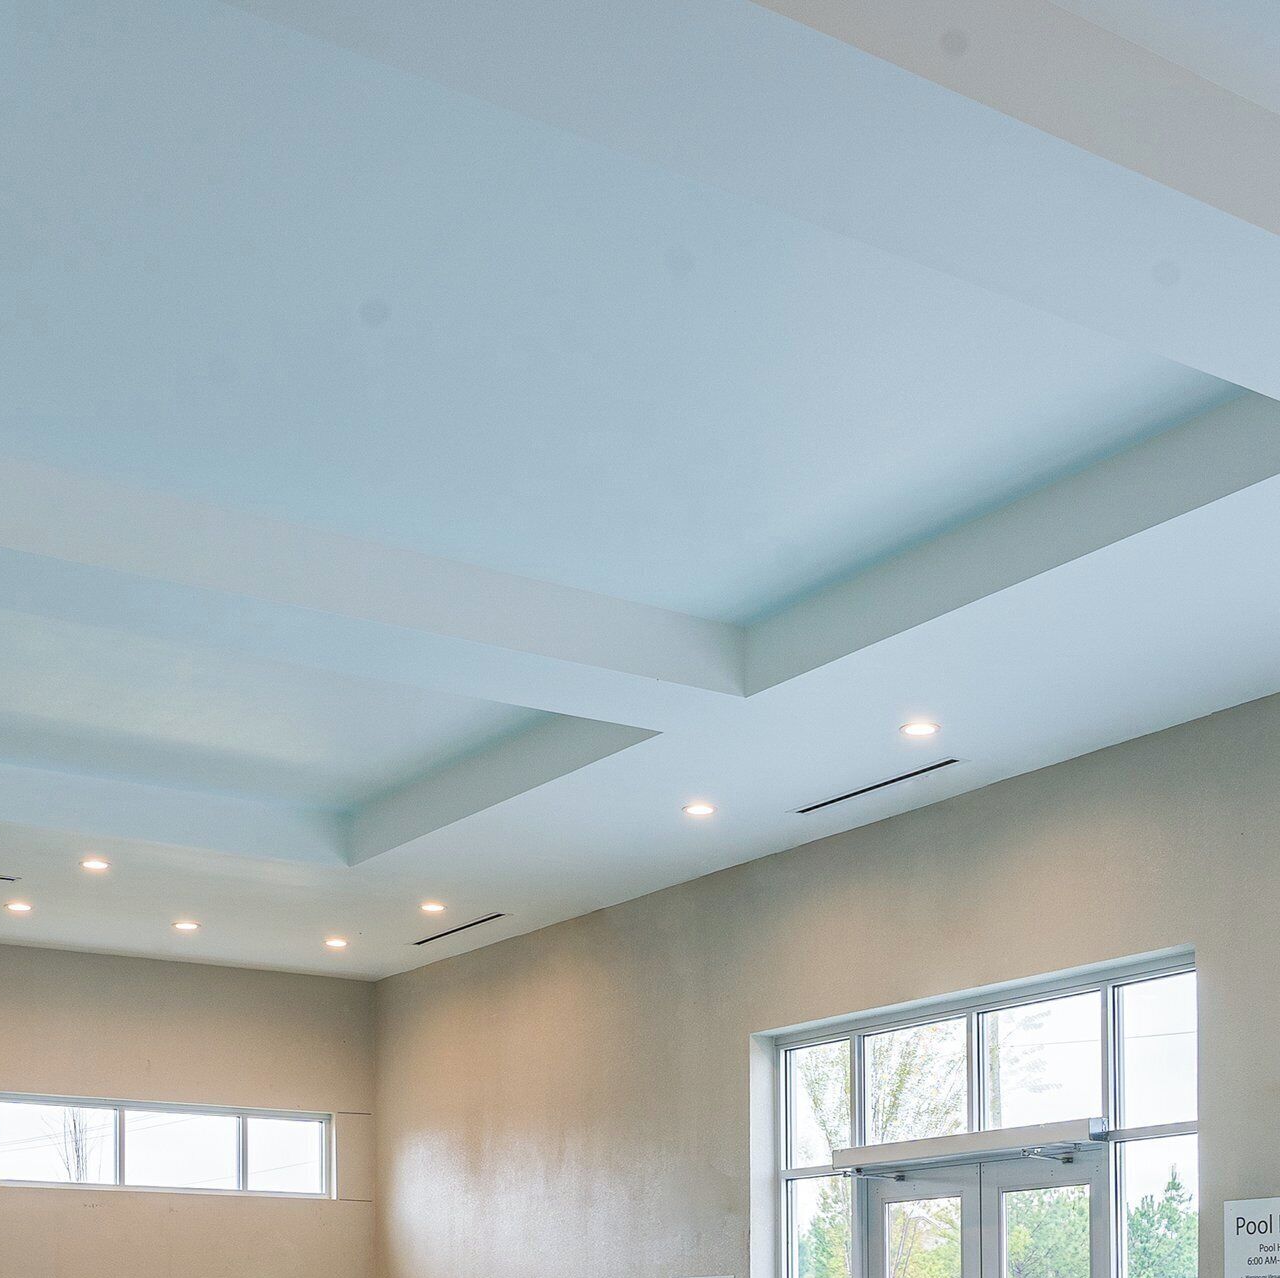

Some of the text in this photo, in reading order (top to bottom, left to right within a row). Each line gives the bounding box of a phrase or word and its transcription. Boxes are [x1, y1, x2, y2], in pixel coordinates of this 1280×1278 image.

[1236, 1213, 1272, 1235] Pool
[1259, 1243, 1276, 1252] Pool
[1247, 1256, 1263, 1265] 6:00
